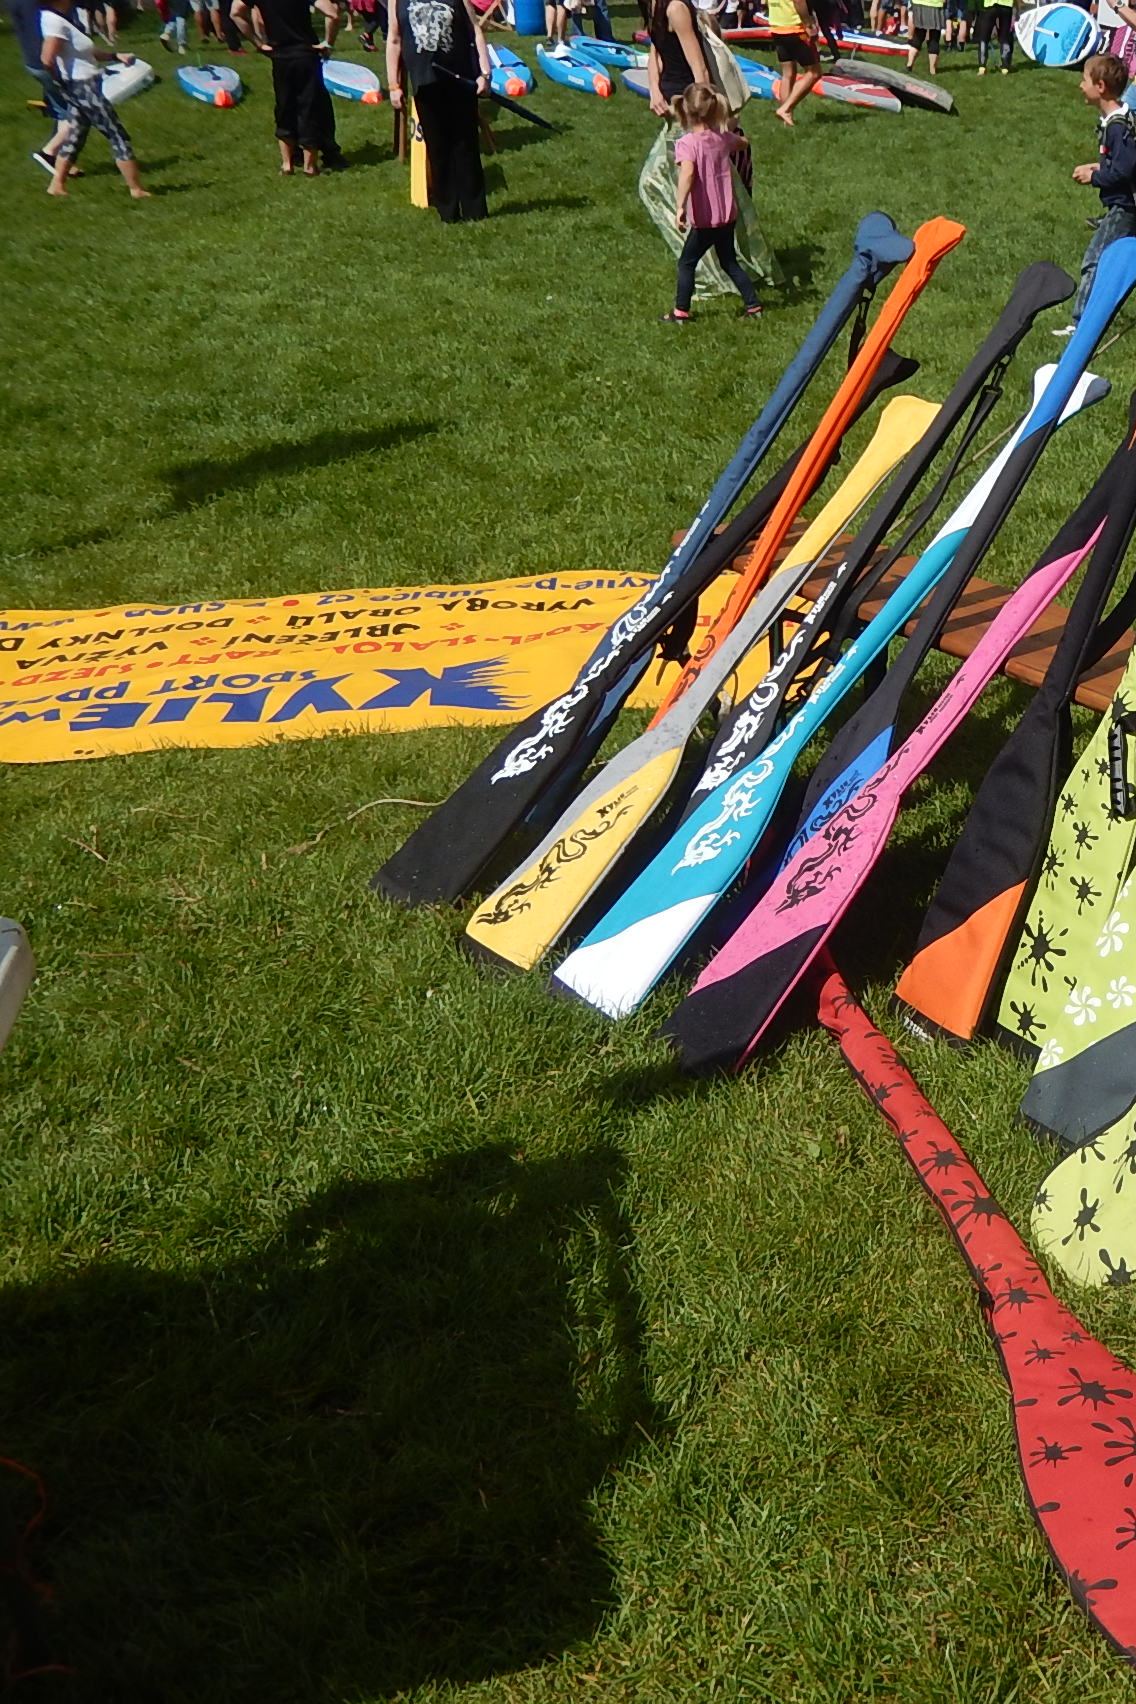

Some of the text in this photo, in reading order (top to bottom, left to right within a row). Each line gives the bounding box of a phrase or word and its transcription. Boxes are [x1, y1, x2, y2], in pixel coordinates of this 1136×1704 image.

[286, 607, 422, 629] OBALŮ
[437, 598, 595, 613] VÝROBA
[37, 617, 234, 650] DOPLŇKY
[11, 663, 135, 686] SJEZD
[146, 669, 320, 697] SPORT
[69, 654, 533, 732] KYLIE
